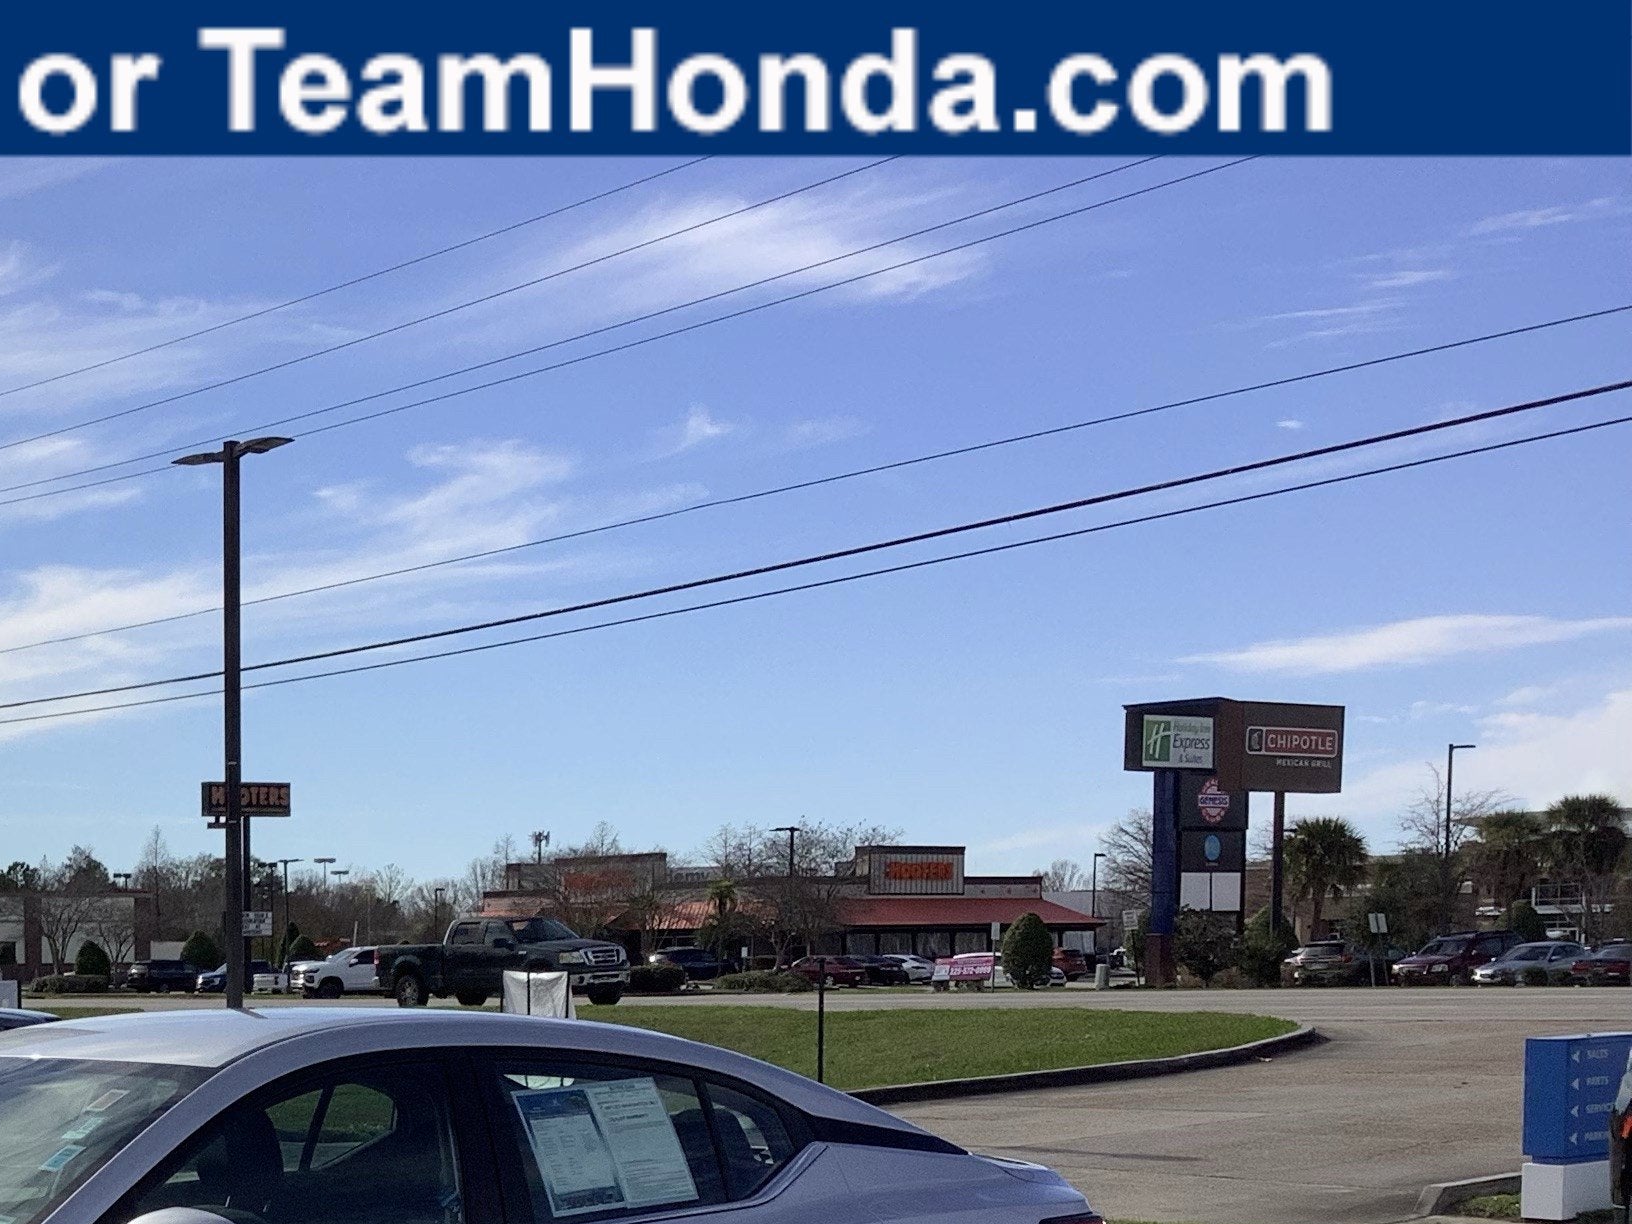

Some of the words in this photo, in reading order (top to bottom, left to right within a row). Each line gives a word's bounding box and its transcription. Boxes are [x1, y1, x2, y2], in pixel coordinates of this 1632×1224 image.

[1173, 733, 1210, 751] Express
[1268, 733, 1334, 751] CHIPOTLE
[1276, 758, 1309, 767] MEXICAN
[211, 785, 289, 806] HOTERS
